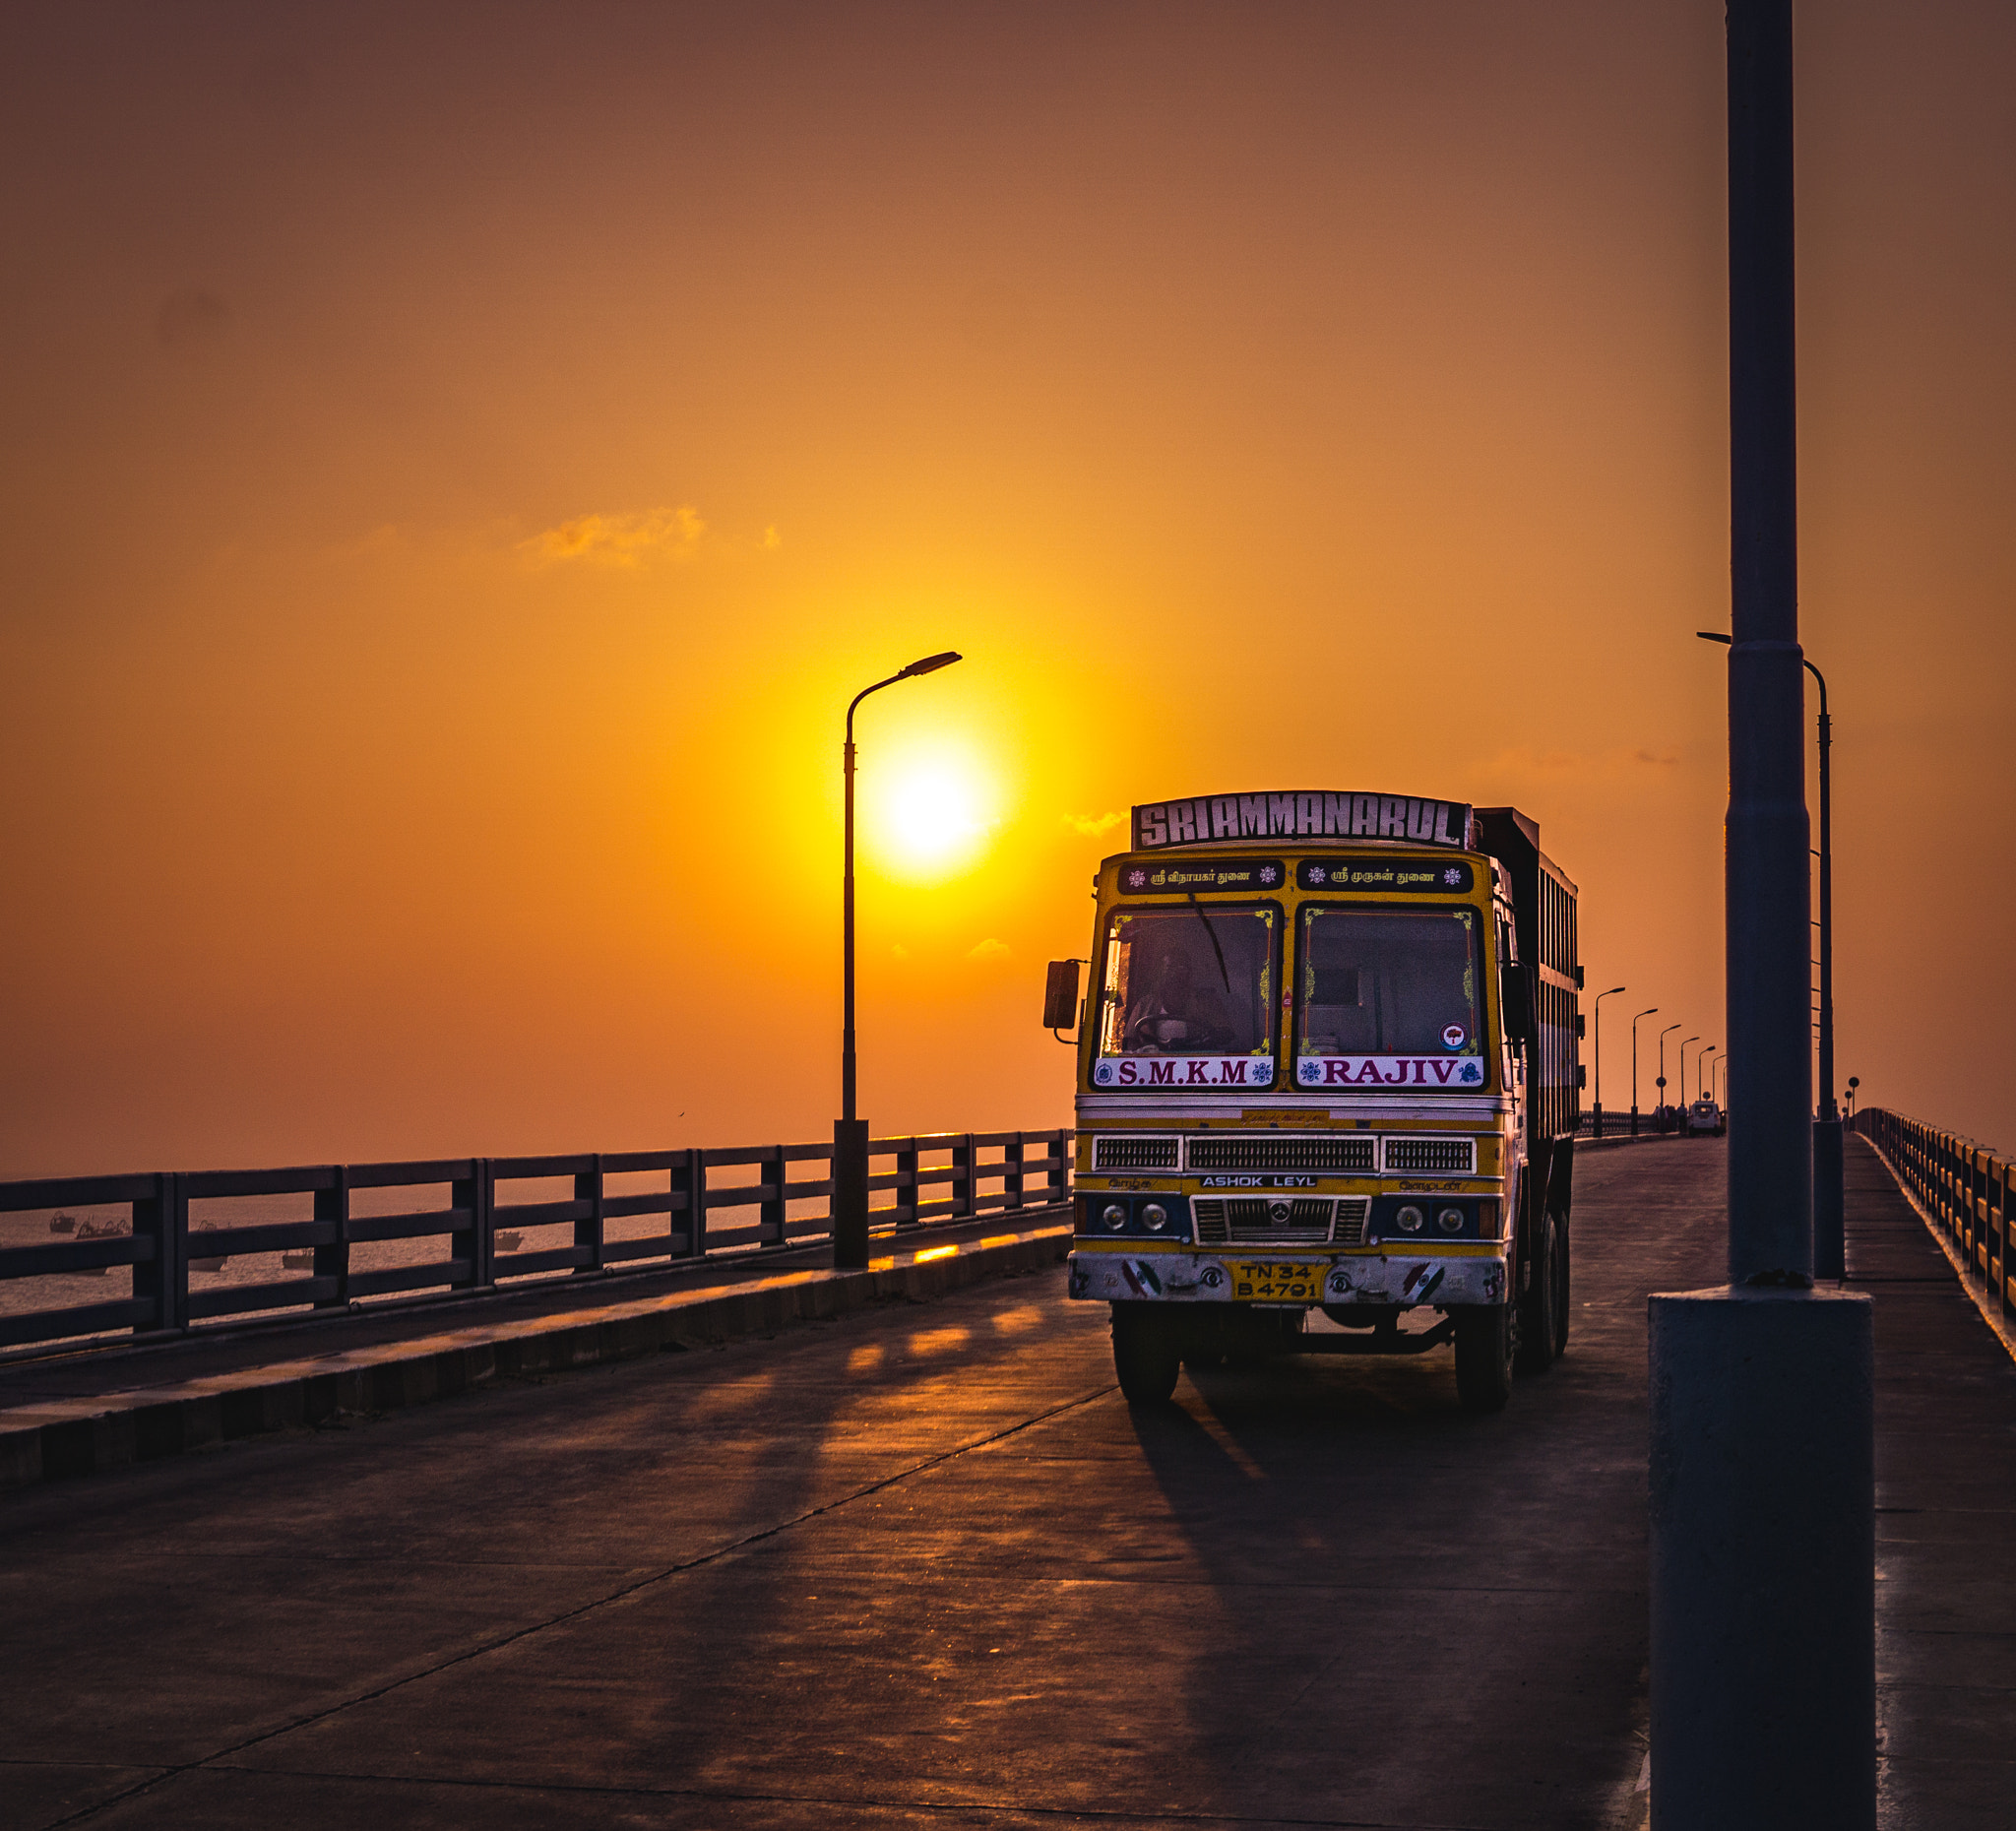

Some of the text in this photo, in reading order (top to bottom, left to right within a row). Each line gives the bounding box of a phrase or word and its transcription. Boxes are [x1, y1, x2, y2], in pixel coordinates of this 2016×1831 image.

[1168, 868, 1216, 885] விநாயகர்
[1217, 871, 1251, 885] துணை
[1351, 868, 1395, 883] முருகன்
[1396, 871, 1435, 885] துணை
[1118, 1060, 1247, 1085] S.M.K.M
[1323, 1059, 1459, 1084] RAJIV
[1202, 1175, 1316, 1187] ASHOK LEYL
[1279, 1265, 1311, 1279] 34
[1257, 1283, 1316, 1296] 4791
